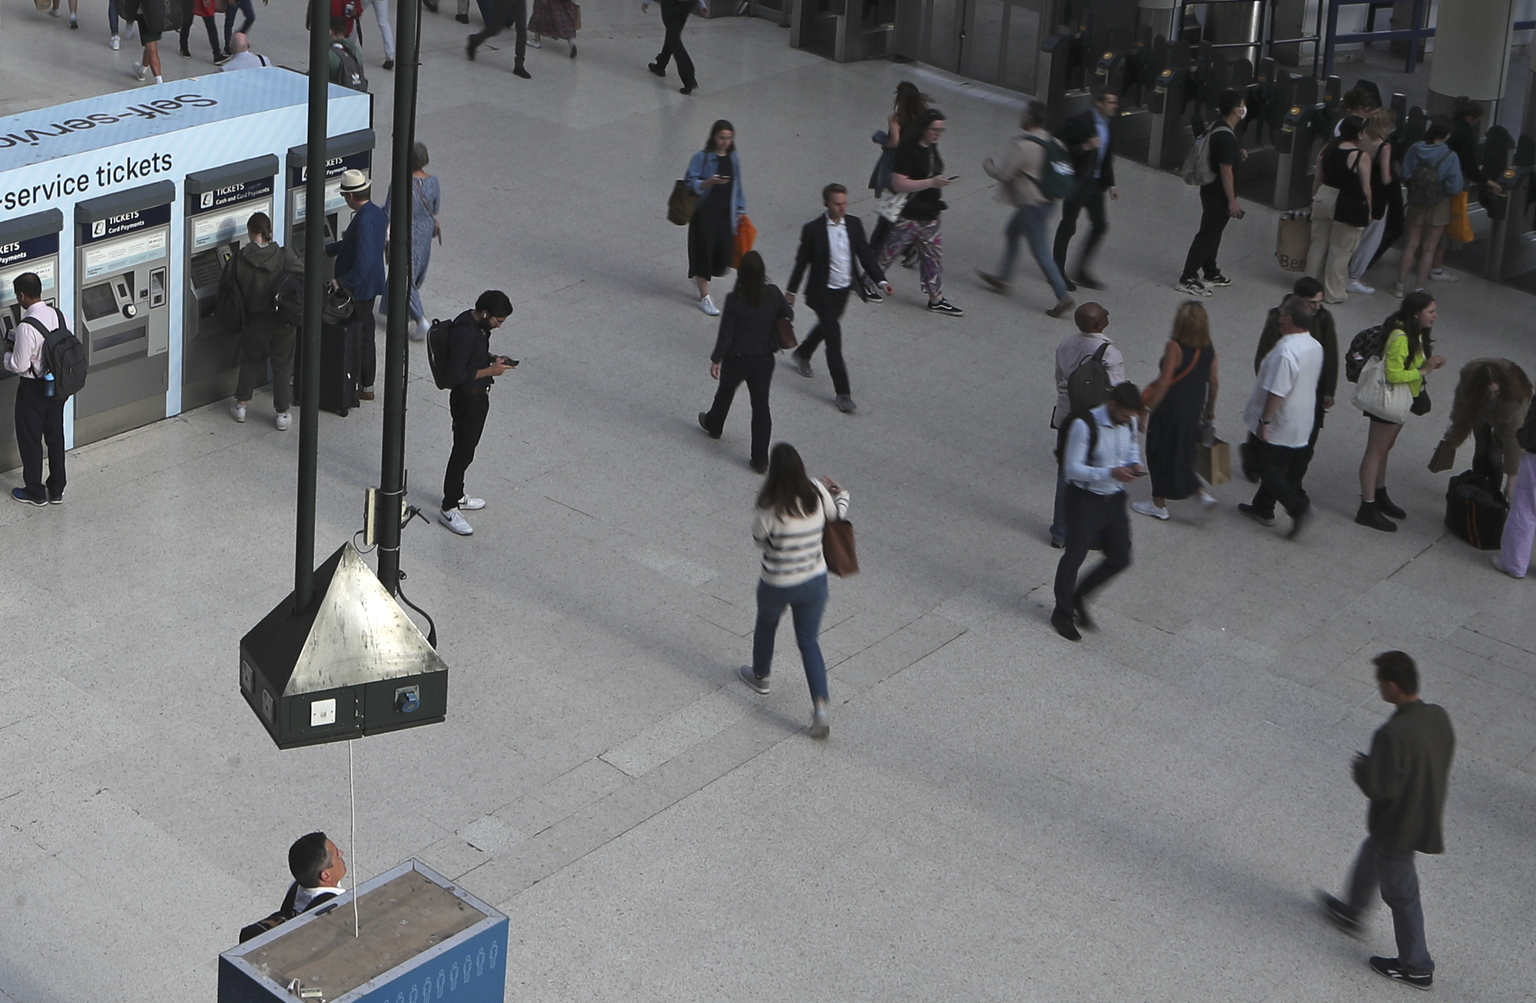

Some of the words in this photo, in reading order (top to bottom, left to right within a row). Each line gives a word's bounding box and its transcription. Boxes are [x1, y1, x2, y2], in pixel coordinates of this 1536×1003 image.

[96, 152, 173, 186] tickets
[326, 165, 348, 176] Payments
[215, 197, 227, 206] Cash
[227, 195, 236, 204] and
[236, 191, 247, 201] Card
[247, 186, 270, 199] Payments
[216, 183, 245, 197] TICKETS
[109, 210, 140, 225] TICKETS
[108, 225, 120, 235] Card
[120, 220, 145, 232] Payments
